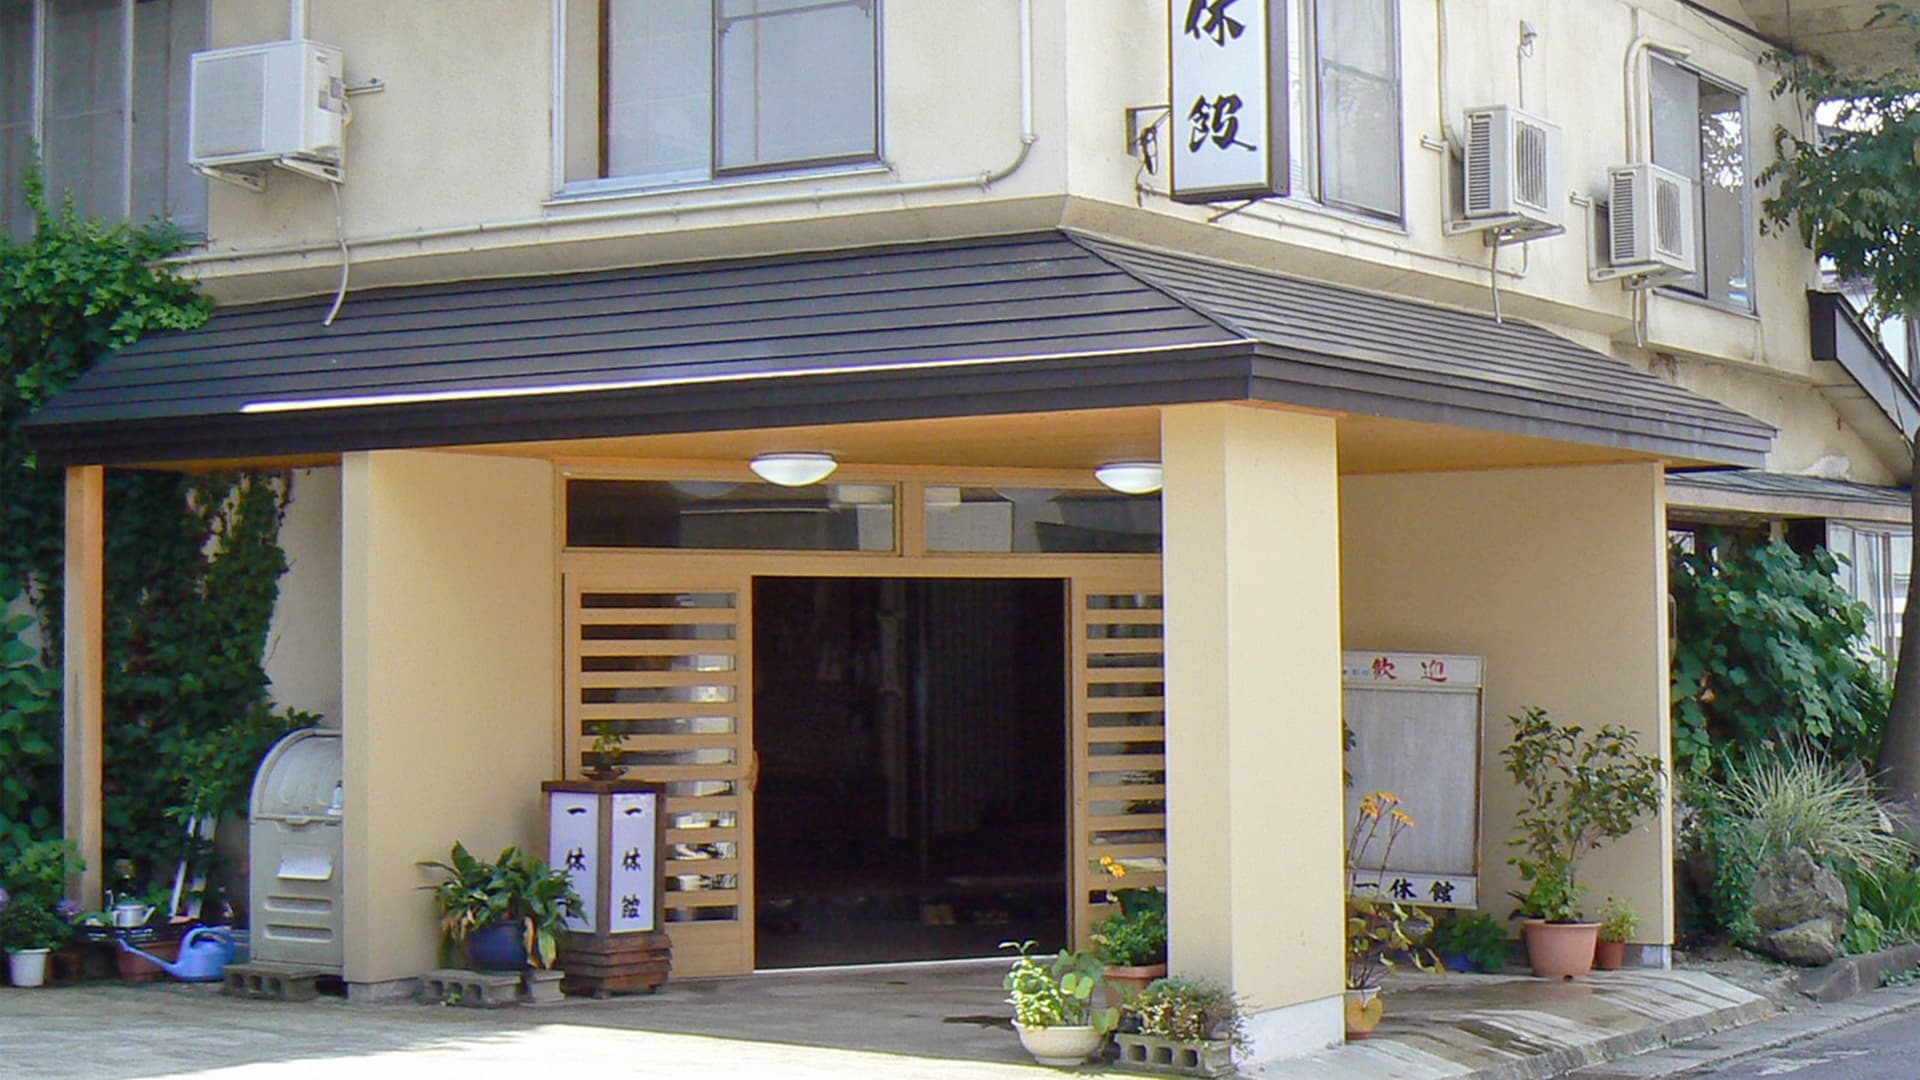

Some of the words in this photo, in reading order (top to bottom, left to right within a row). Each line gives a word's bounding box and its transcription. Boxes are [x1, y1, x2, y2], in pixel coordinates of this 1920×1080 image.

[566, 807, 587, 918] 一休
[1355, 878, 1455, 902] 一休館
